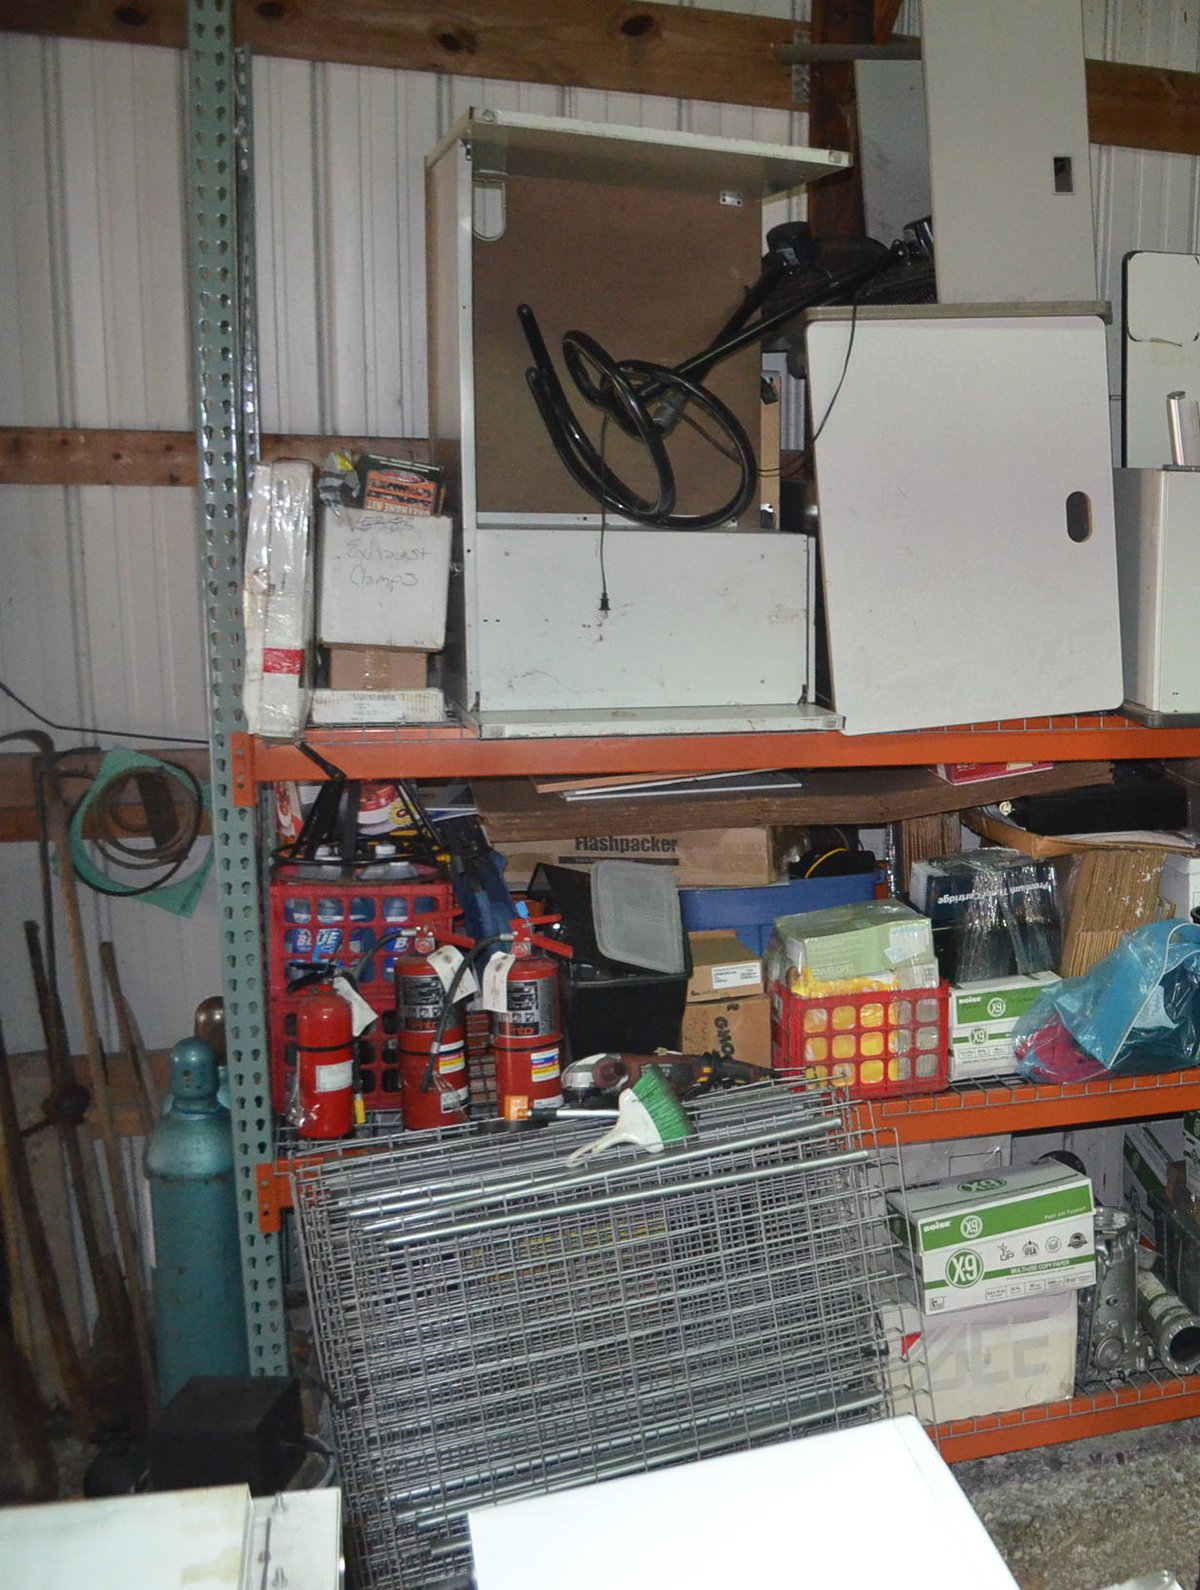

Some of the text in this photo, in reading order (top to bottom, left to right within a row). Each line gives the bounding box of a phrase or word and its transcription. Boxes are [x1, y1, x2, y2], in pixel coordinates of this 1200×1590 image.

[575, 835, 678, 853] Flashpacker
[937, 891, 981, 905] Cartridge
[297, 930, 340, 947] BLUE
